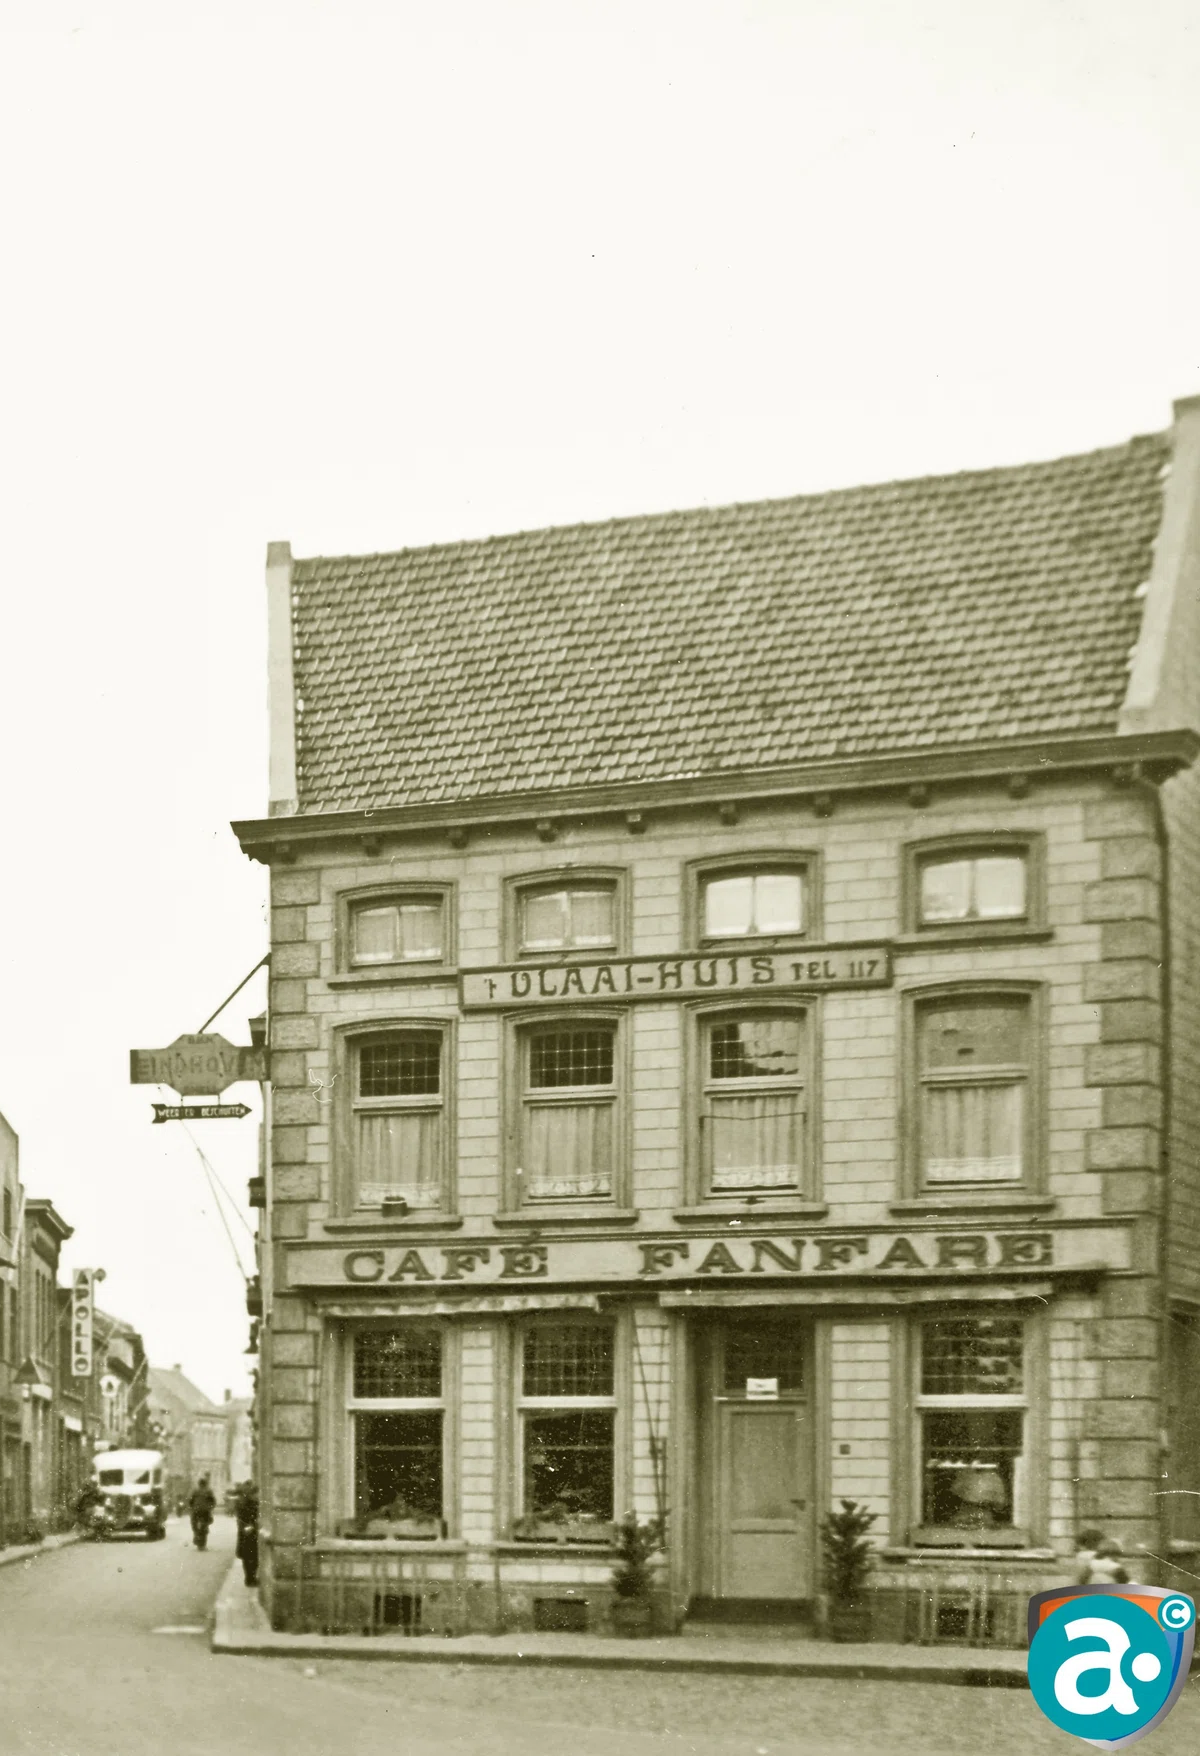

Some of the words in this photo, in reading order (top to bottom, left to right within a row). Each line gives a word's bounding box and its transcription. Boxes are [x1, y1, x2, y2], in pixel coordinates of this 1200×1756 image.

[791, 961, 836, 981] TEL
[850, 960, 879, 978] 117
[138, 1055, 264, 1076] EINDHOVN
[158, 1108, 195, 1118] WEERER
[343, 1231, 548, 1282] CAFÉ
[638, 1234, 1053, 1274] FANFARE
[74, 1270, 89, 1372] APOLLO
